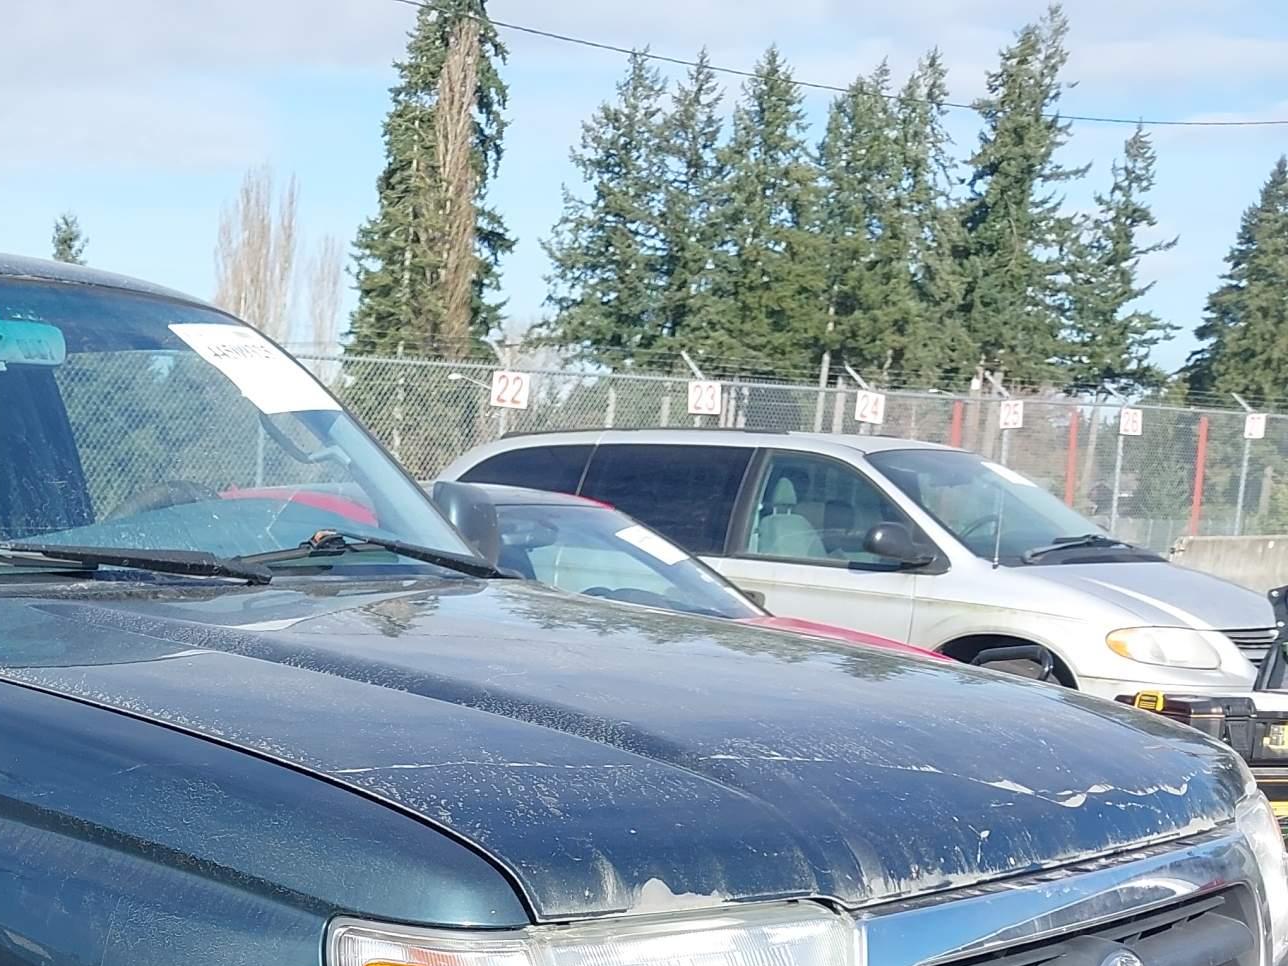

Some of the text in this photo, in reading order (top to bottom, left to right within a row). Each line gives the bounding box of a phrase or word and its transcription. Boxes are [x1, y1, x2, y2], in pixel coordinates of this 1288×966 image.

[496, 374, 523, 405] 22
[693, 384, 717, 411] 23
[859, 393, 880, 418] 24
[1003, 403, 1020, 426] 25
[1123, 411, 1138, 433] 26
